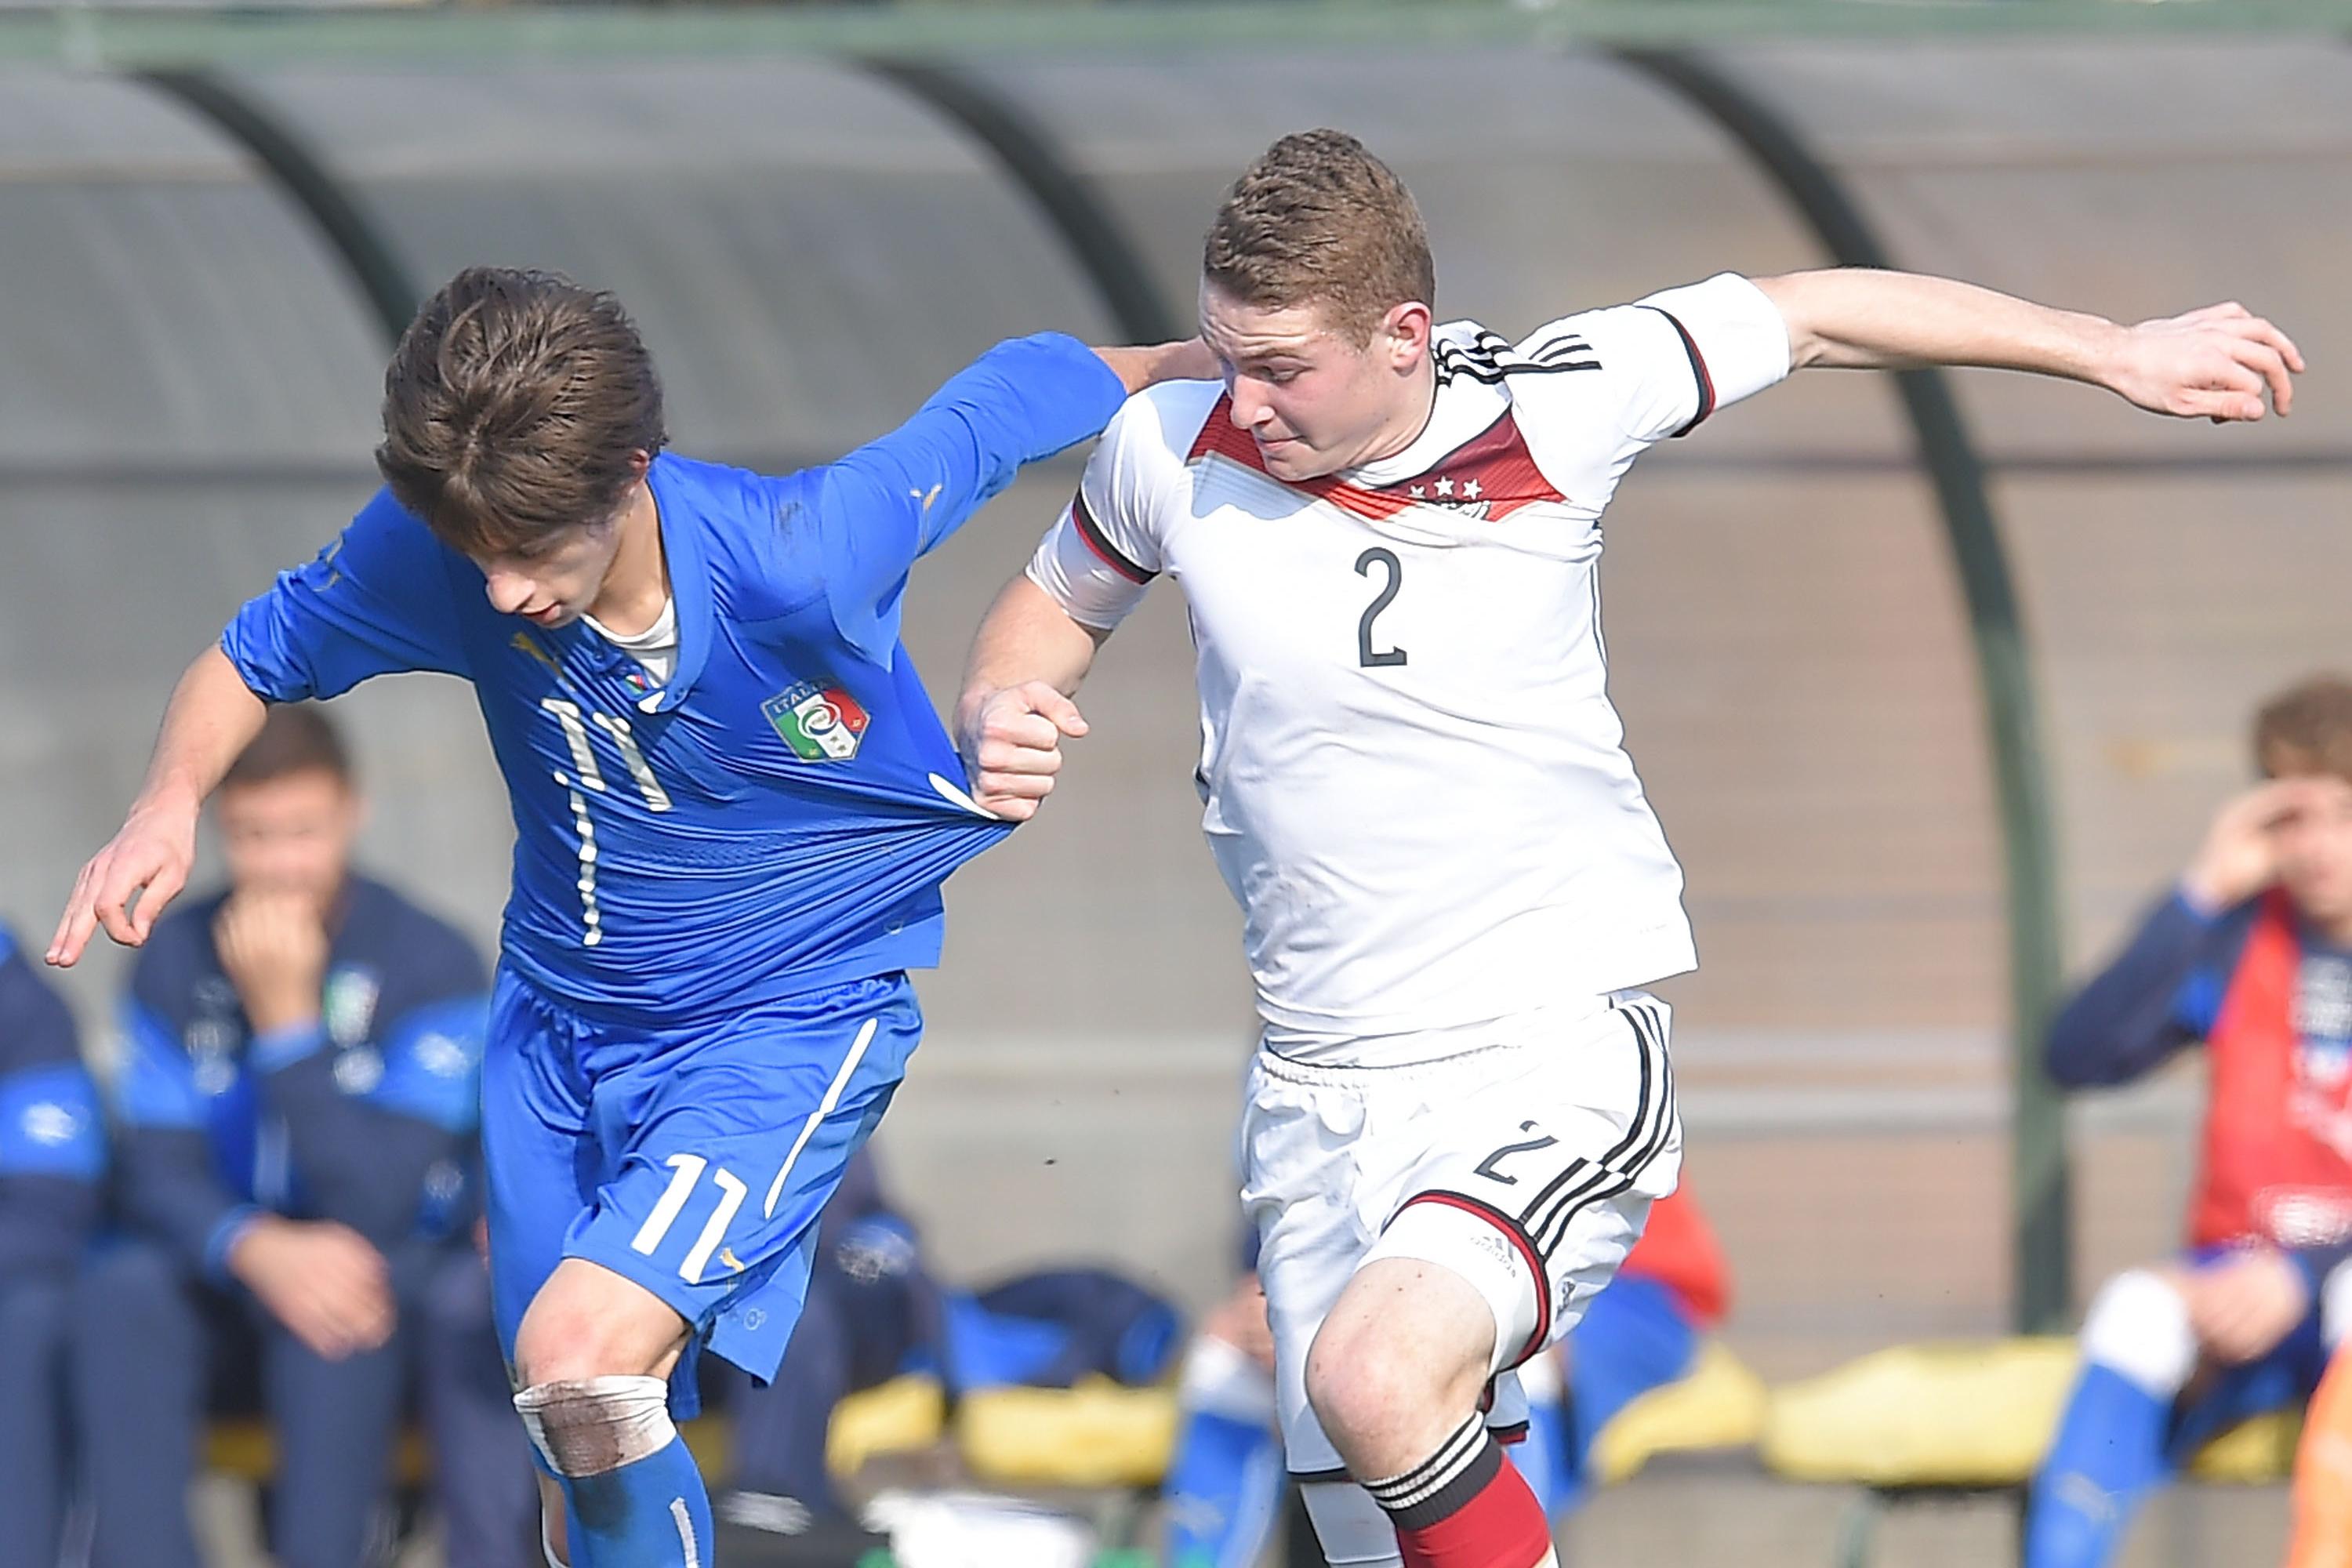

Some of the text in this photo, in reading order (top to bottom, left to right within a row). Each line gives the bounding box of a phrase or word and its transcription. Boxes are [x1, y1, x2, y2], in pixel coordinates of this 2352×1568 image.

[1355, 546, 1408, 667] 2
[542, 699, 671, 811] 11
[1473, 1120, 1560, 1185] 2
[631, 1153, 747, 1283] 11
